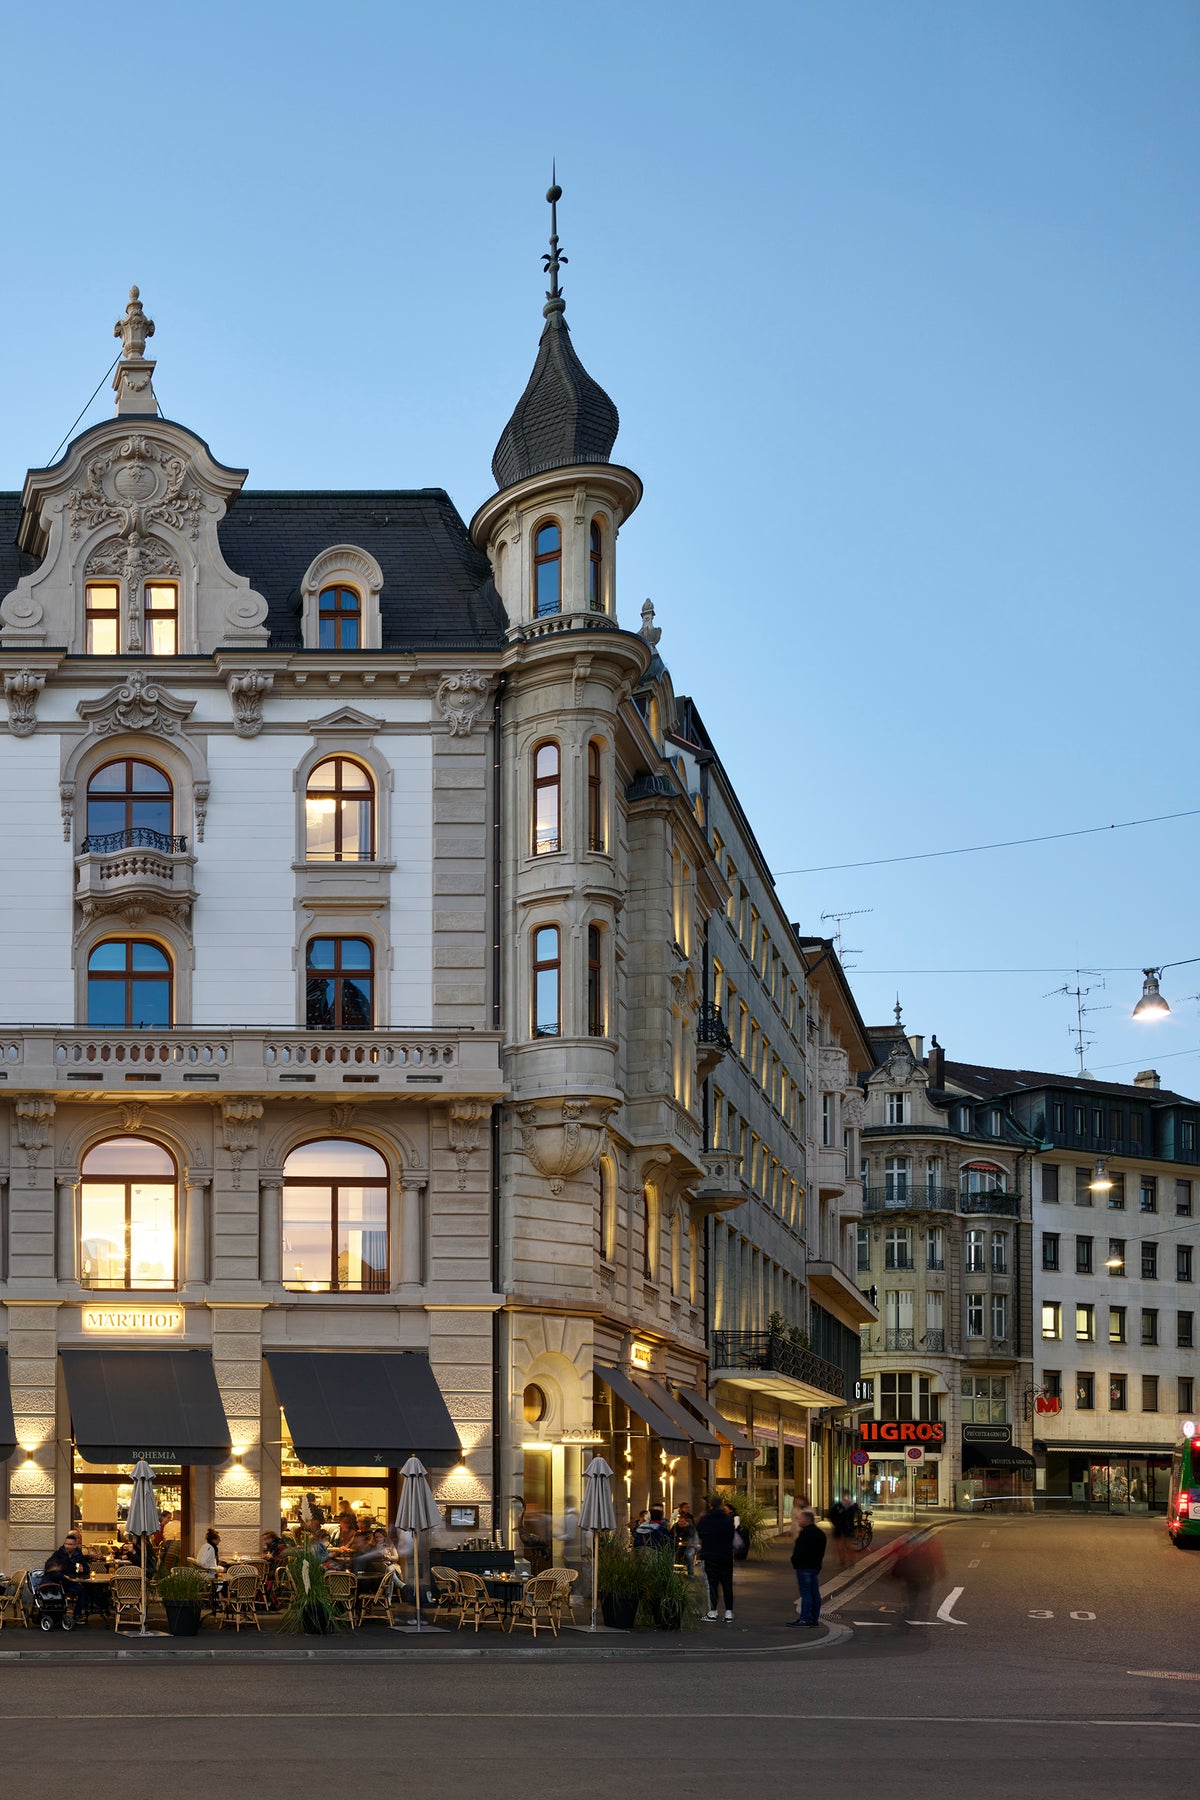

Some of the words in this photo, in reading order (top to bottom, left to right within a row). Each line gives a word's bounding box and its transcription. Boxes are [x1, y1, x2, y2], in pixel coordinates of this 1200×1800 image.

[88, 1313, 179, 1327] MÄRTHOF
[132, 1451, 176, 1459] BOHEMIA
[1027, 1609, 1097, 1620] 30
